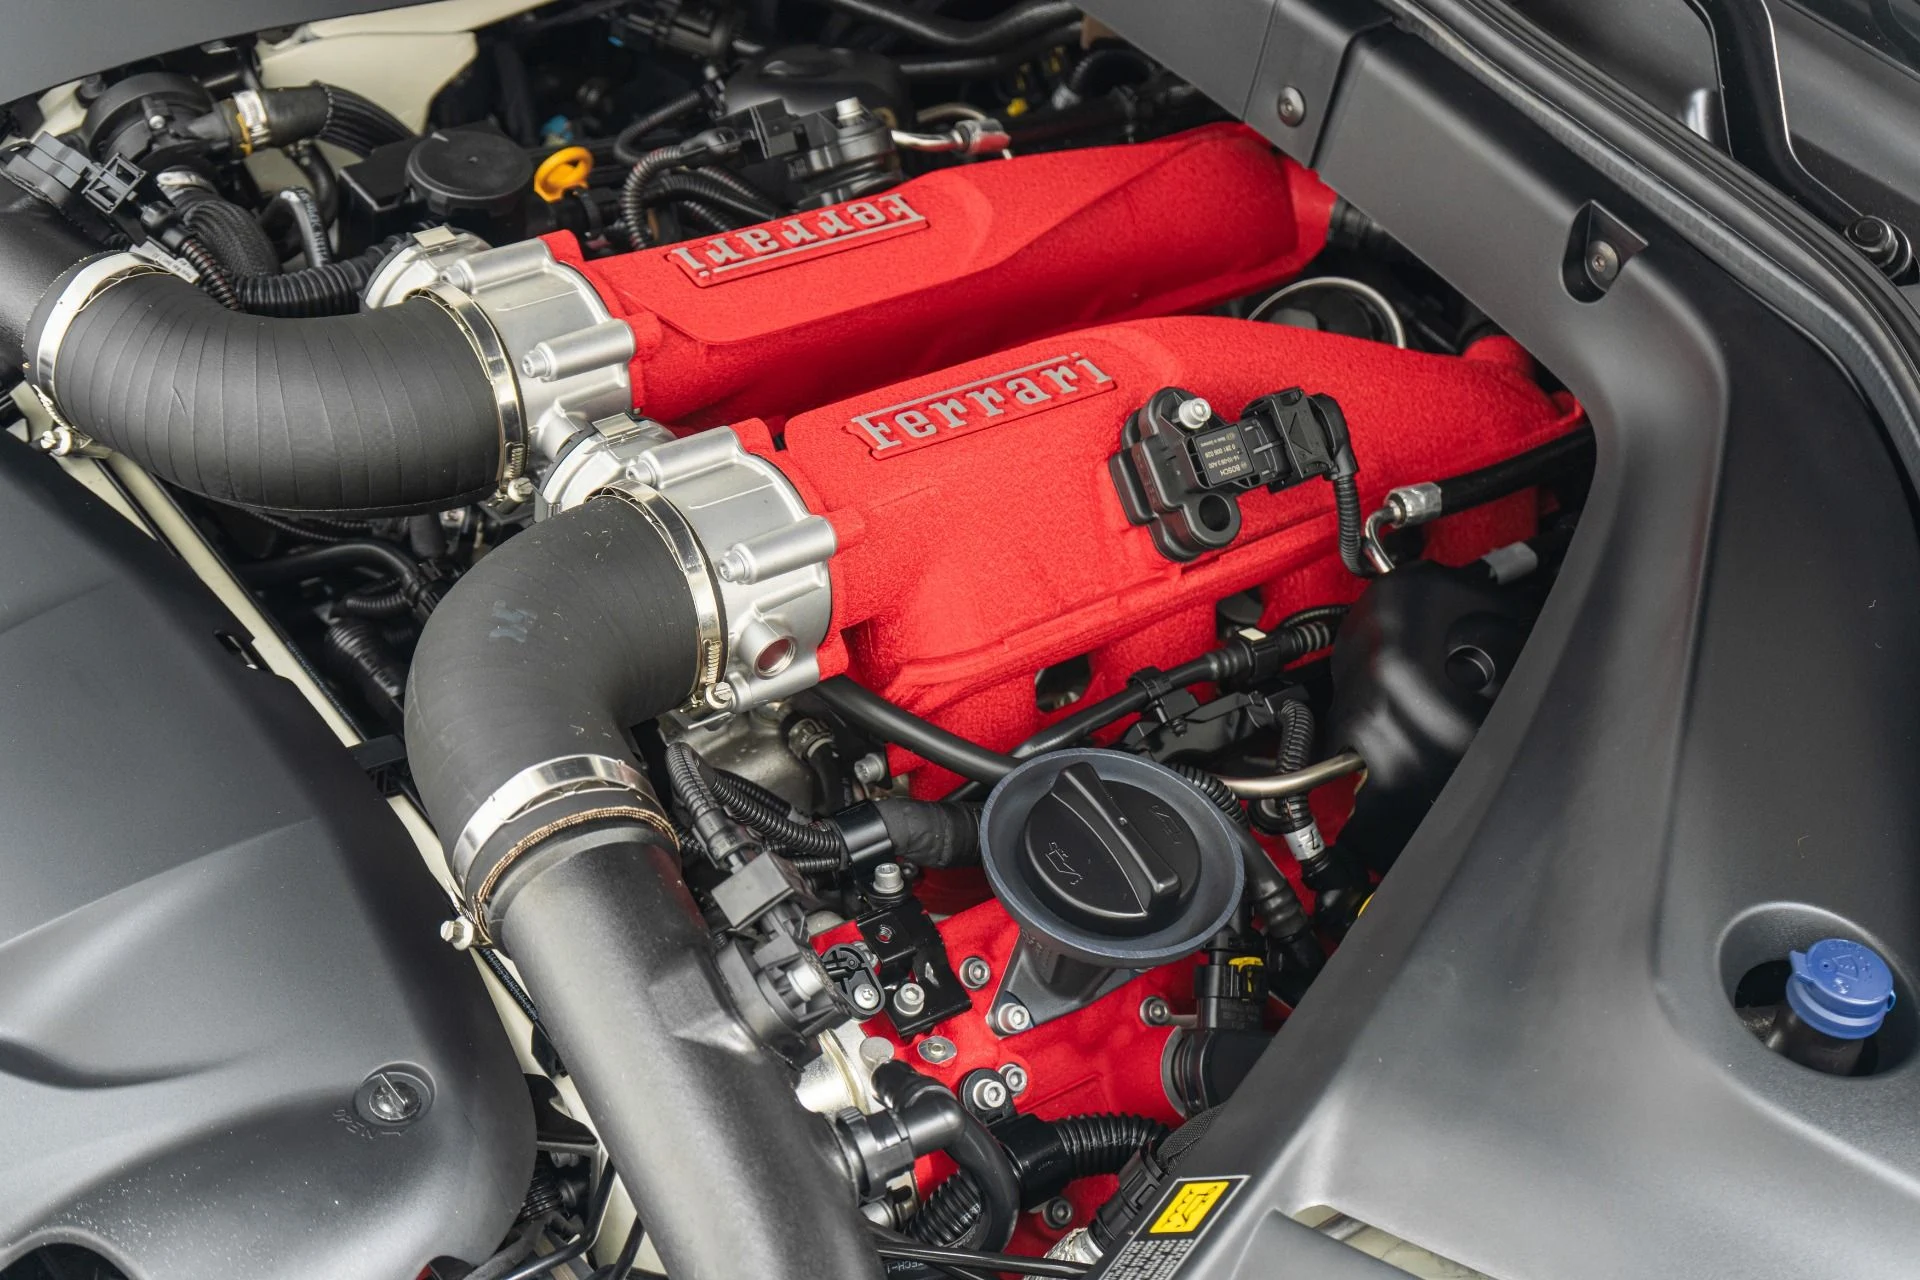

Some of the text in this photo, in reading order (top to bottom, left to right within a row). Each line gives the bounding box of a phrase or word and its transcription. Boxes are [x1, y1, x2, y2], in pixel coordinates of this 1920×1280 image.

[671, 193, 925, 277] Ferrari
[851, 352, 1112, 450] Ferrari
[1218, 463, 1240, 476] BOSCH
[332, 1109, 378, 1142] OPEN
